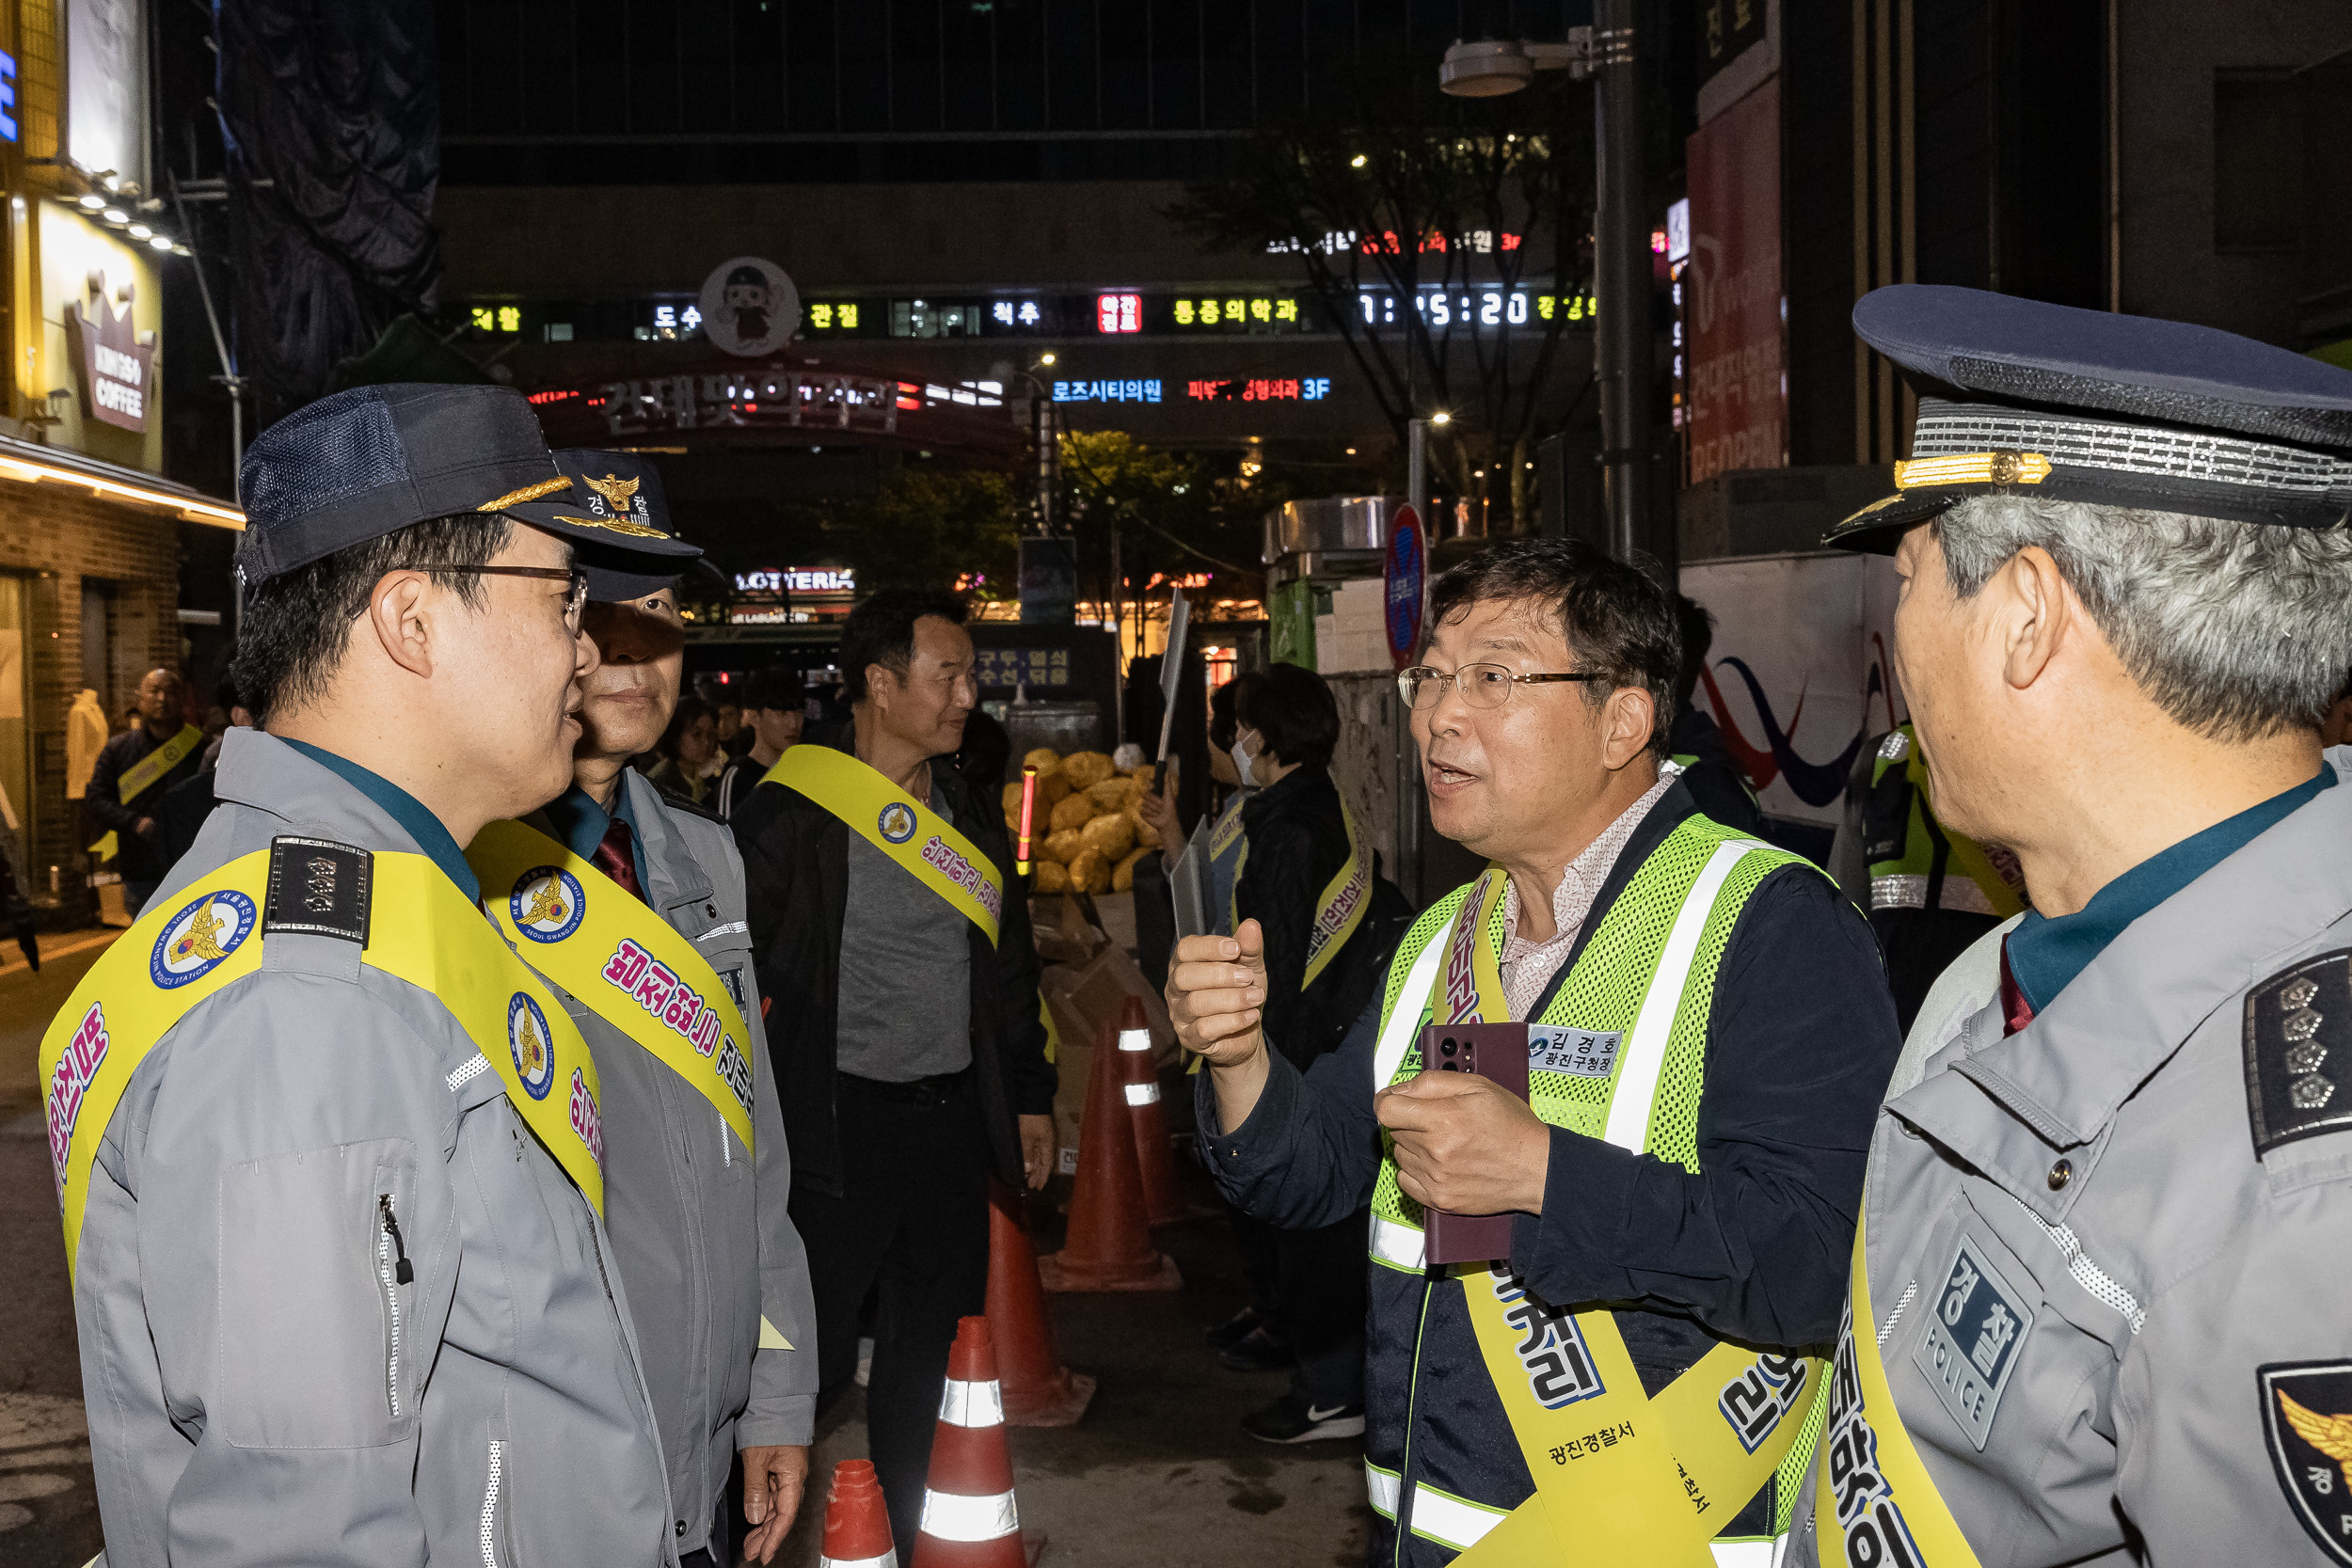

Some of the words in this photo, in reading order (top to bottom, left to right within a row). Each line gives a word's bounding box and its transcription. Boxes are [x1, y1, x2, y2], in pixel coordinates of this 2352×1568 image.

[655, 306, 702, 328] 도수
[1174, 300, 1297, 325] 통증의학과
[96, 377, 143, 419] COFFEE
[1052, 378, 1162, 403] 로즈시티의원
[1303, 378, 1330, 400] 3F
[735, 570, 855, 591] LOTTERIA
[563, 875, 581, 898] STATION
[574, 897, 583, 921] POLICE
[526, 928, 545, 941] SEOUL
[547, 921, 577, 941] GWANGJIN
[174, 963, 209, 985] STATION
[602, 939, 721, 1058] 범죄없는
[1545, 1051, 1611, 1071] 광진구청장
[1941, 1258, 2016, 1379] 경찰
[1924, 1325, 1986, 1423] POLICE
[1549, 1419, 1636, 1465] 광진경찰서
